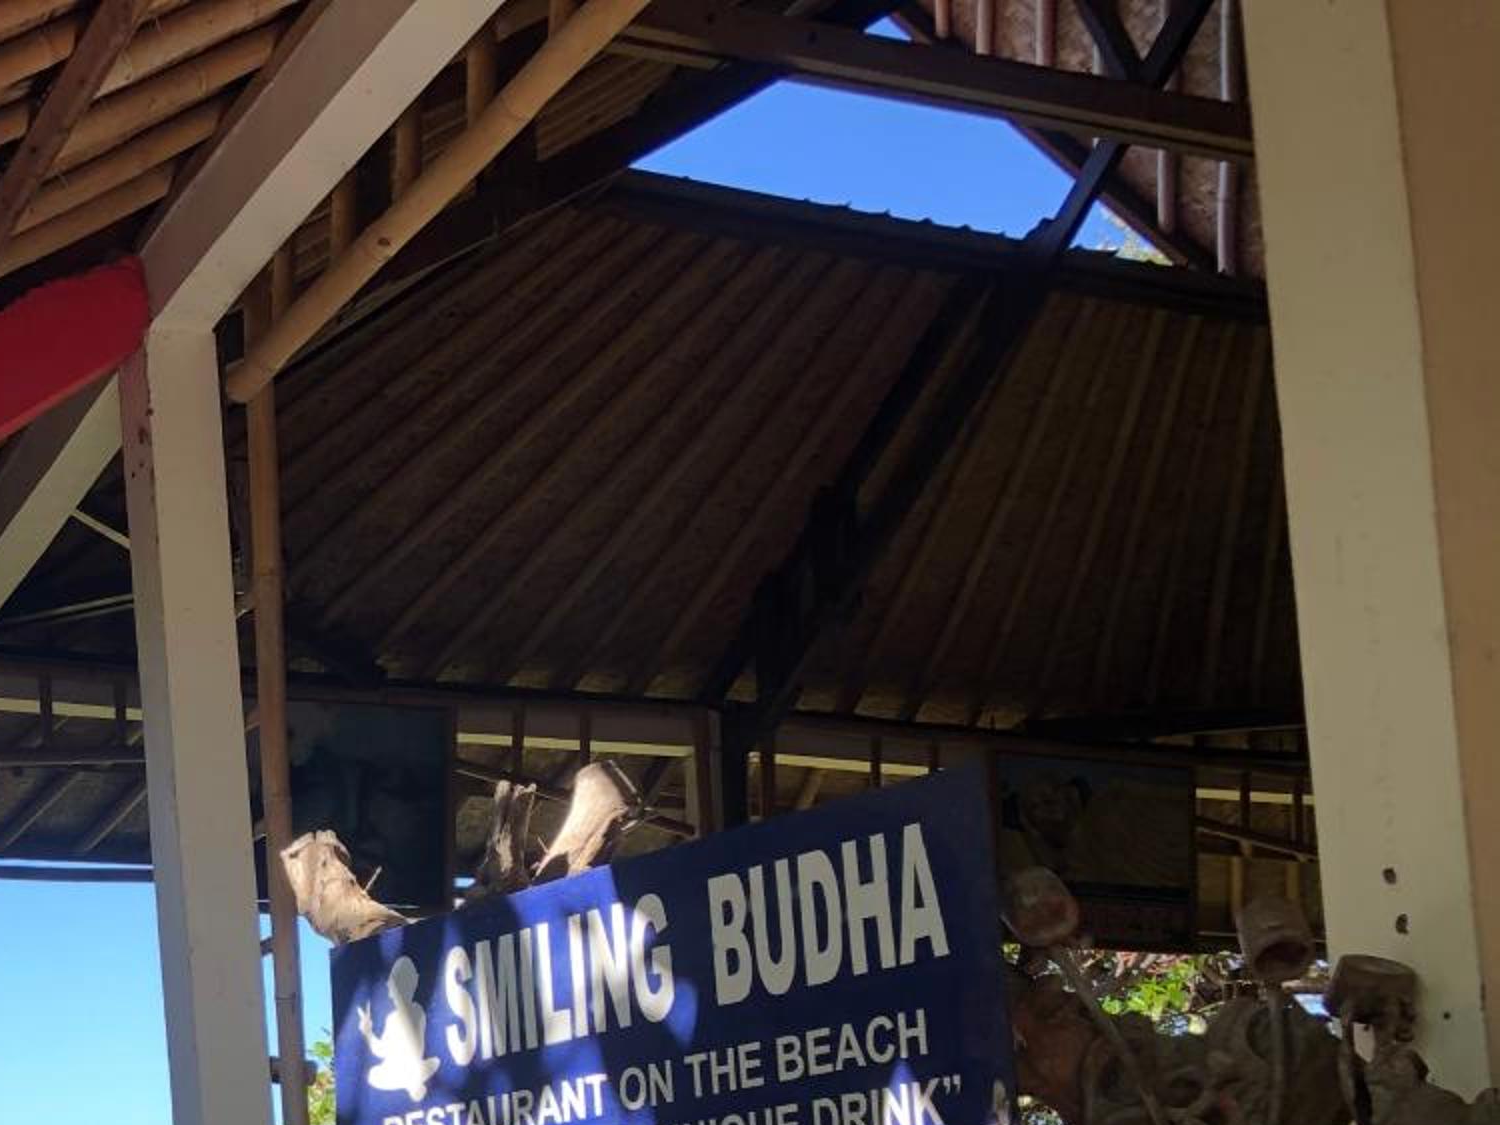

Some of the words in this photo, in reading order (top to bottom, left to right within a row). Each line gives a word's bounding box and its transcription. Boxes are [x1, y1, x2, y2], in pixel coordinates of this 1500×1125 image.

[444, 893, 676, 1068] SMILING
[707, 823, 950, 1007] BUDHA
[619, 1064, 676, 1112] ON
[684, 1041, 766, 1098] THE
[777, 1009, 929, 1081] BEACH
